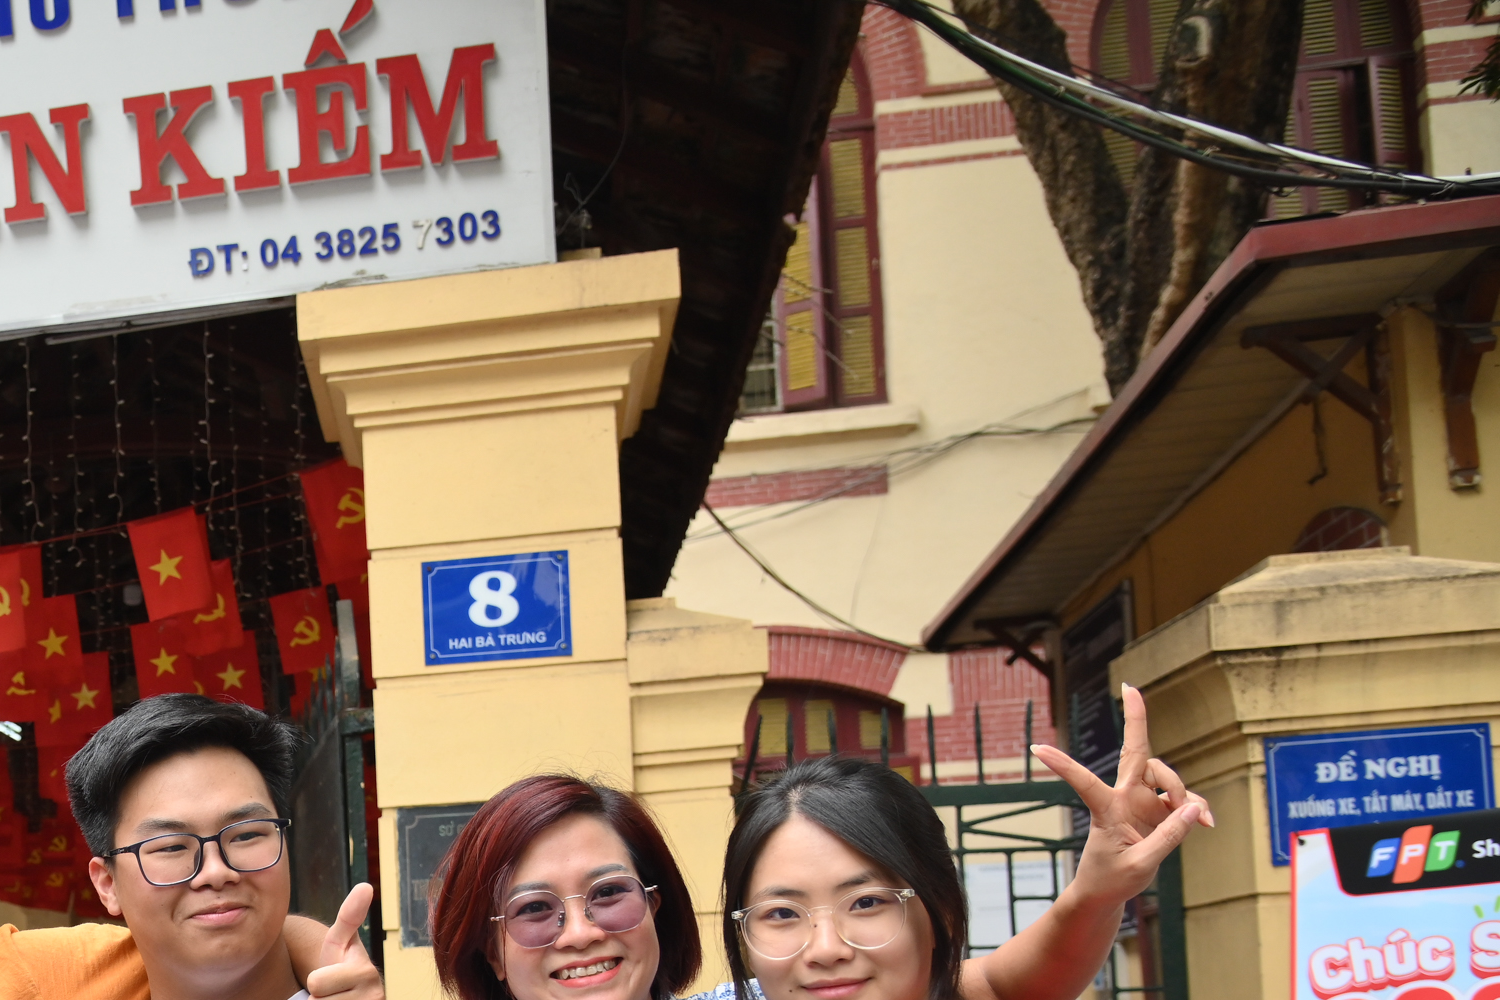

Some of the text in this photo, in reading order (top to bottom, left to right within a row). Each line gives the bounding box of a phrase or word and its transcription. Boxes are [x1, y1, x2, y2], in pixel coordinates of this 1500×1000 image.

[122, 0, 501, 208] KIẾM
[188, 209, 502, 278] ĐT: 04 3825 7303
[468, 570, 520, 628] 8
[448, 630, 548, 650] HAI BÀ TRƯNG
[1314, 749, 1443, 784] ĐỀ NGHỊ
[1288, 794, 1336, 819] XUỐNG
[1455, 789, 1475, 807] XE
[1309, 928, 1455, 996] Chúc
